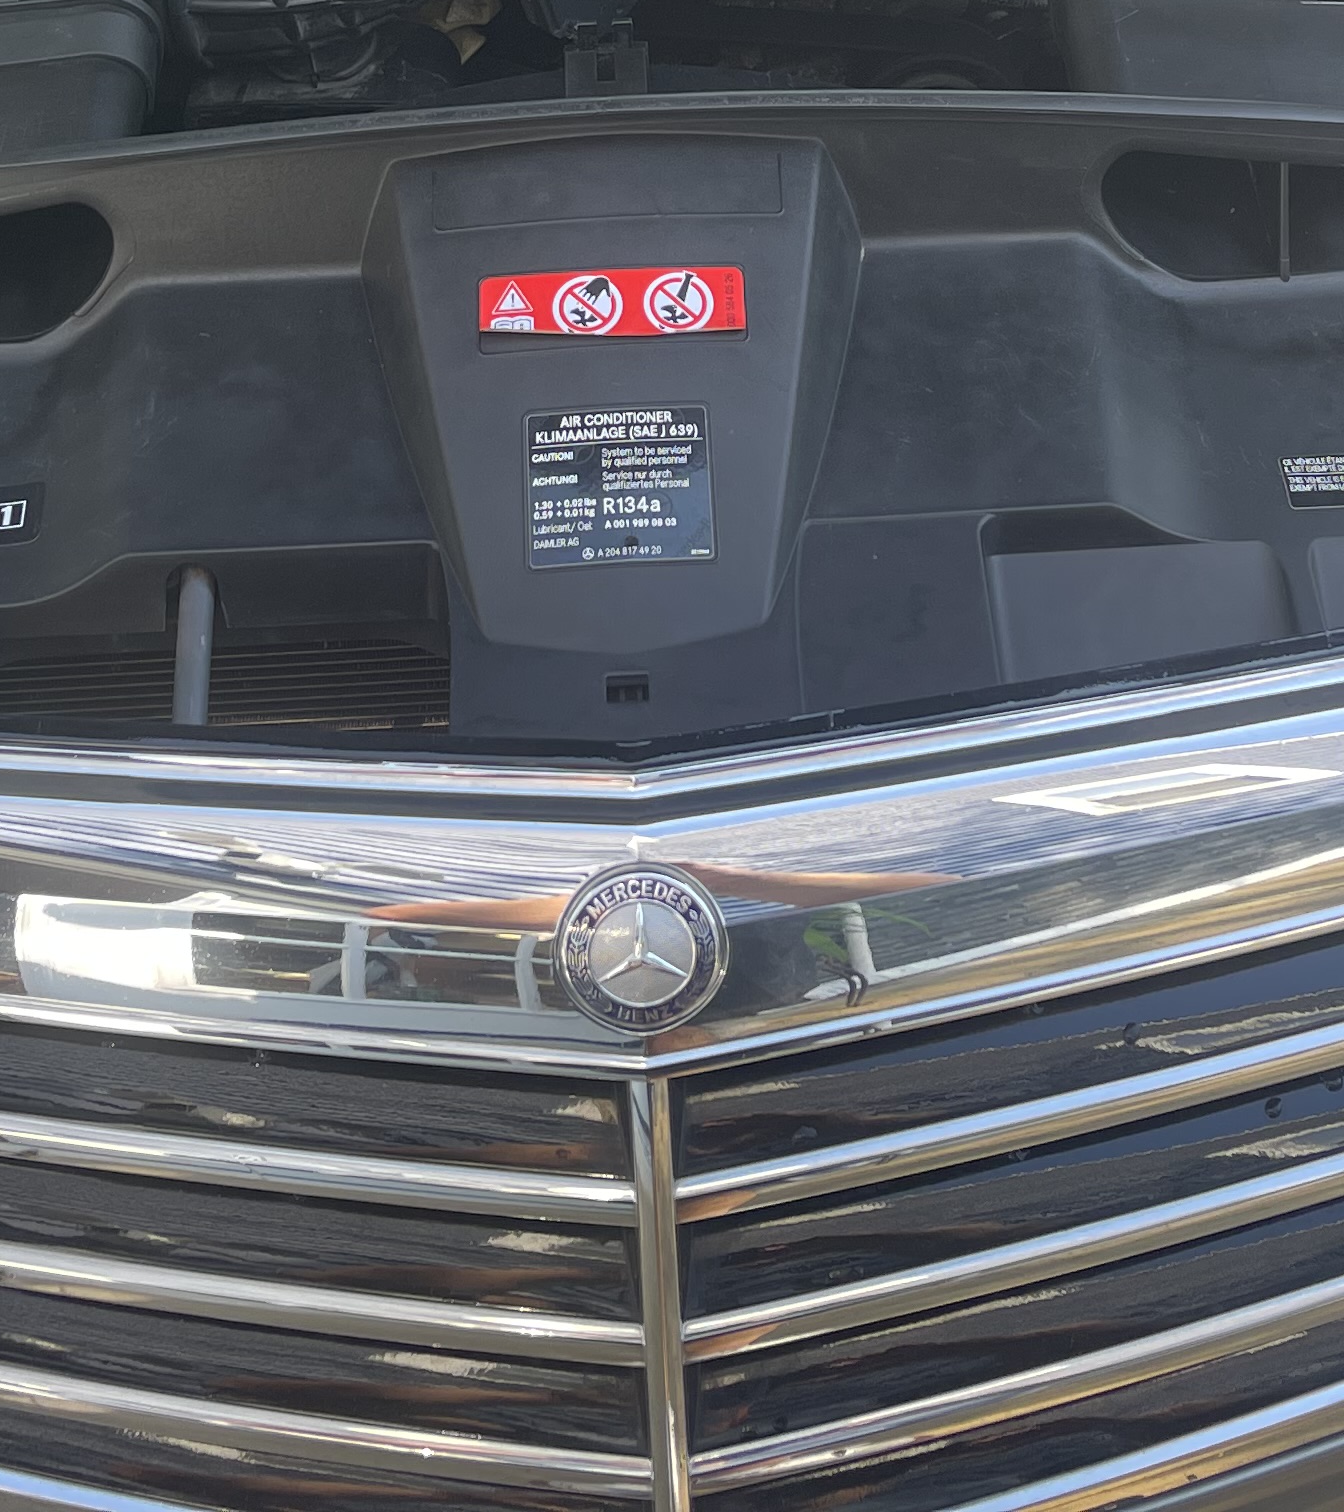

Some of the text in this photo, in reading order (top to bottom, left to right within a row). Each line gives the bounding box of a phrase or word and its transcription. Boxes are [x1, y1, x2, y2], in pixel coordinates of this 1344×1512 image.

[560, 410, 672, 428] AIR CONDITIONER
[535, 423, 699, 444] KLIMAANLAGE (SAE J 639)
[601, 444, 692, 460] System to be serviced
[601, 454, 688, 469] by qualified personnel
[601, 469, 672, 482] Service nur durch
[655, 478, 690, 489] Personal
[584, 507, 596, 518] kg
[603, 496, 661, 515] R134a
[605, 520, 612, 529] A
[613, 520, 629, 529] 001
[533, 537, 580, 550] DAIMLER AG
[597, 548, 604, 557] A
[605, 547, 621, 556] 204
[638, 546, 650, 555] 49
[651, 545, 662, 554] 20
[585, 879, 693, 920] MERCEDES
